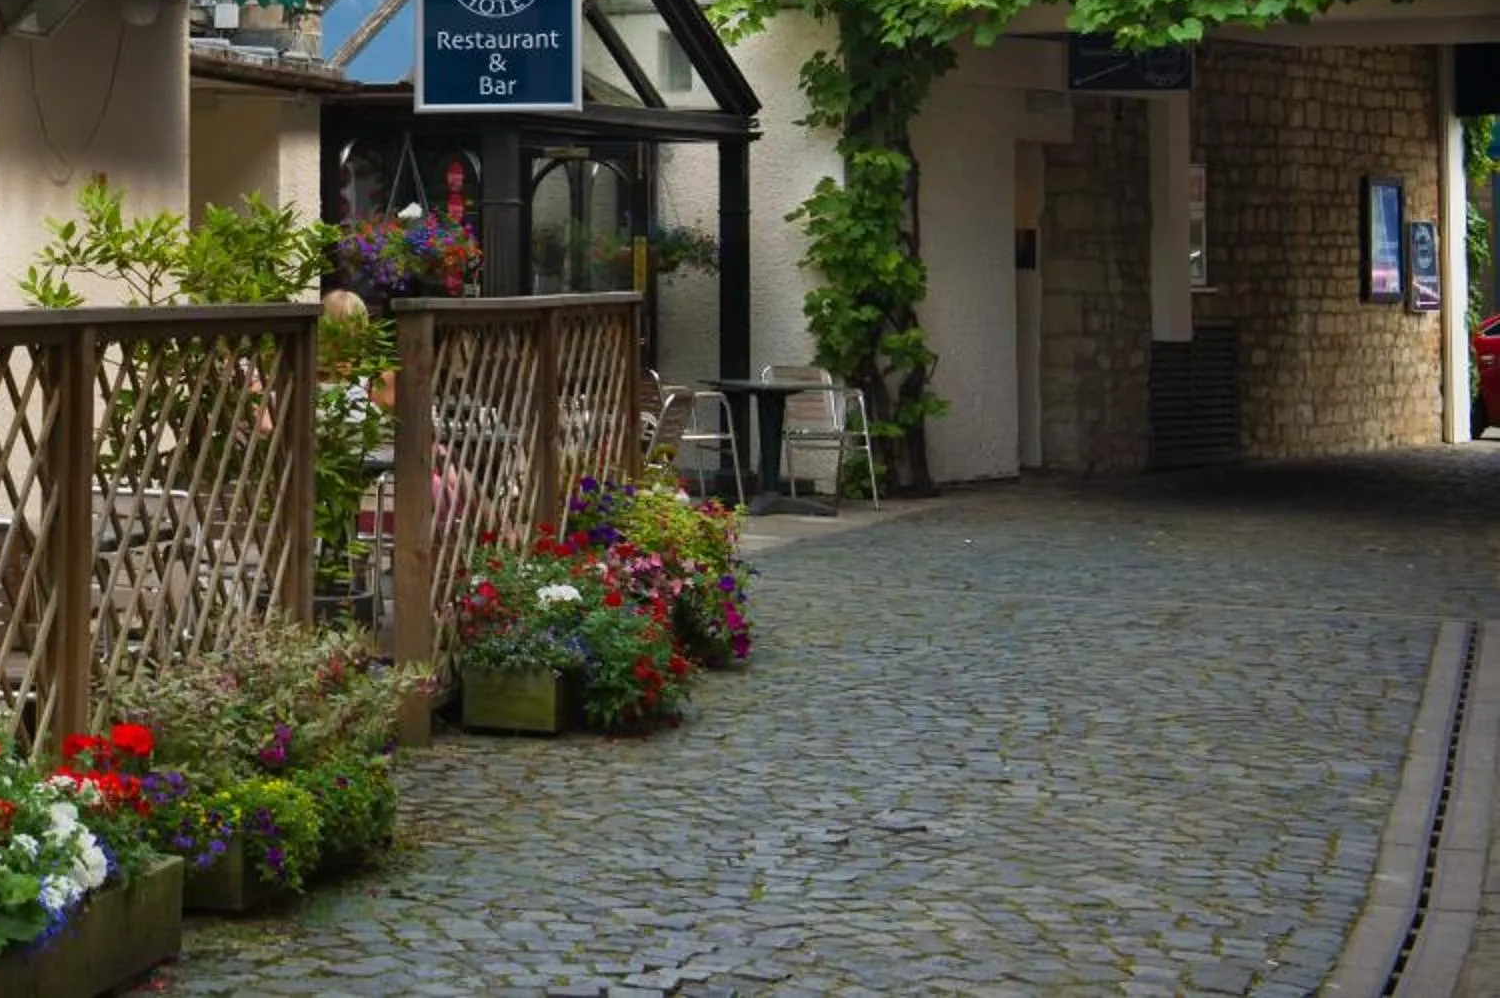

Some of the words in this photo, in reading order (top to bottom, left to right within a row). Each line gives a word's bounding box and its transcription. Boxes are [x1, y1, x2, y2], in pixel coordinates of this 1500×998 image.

[437, 30, 559, 50] Restaurant
[489, 53, 507, 73] &
[480, 77, 517, 96] Bar
